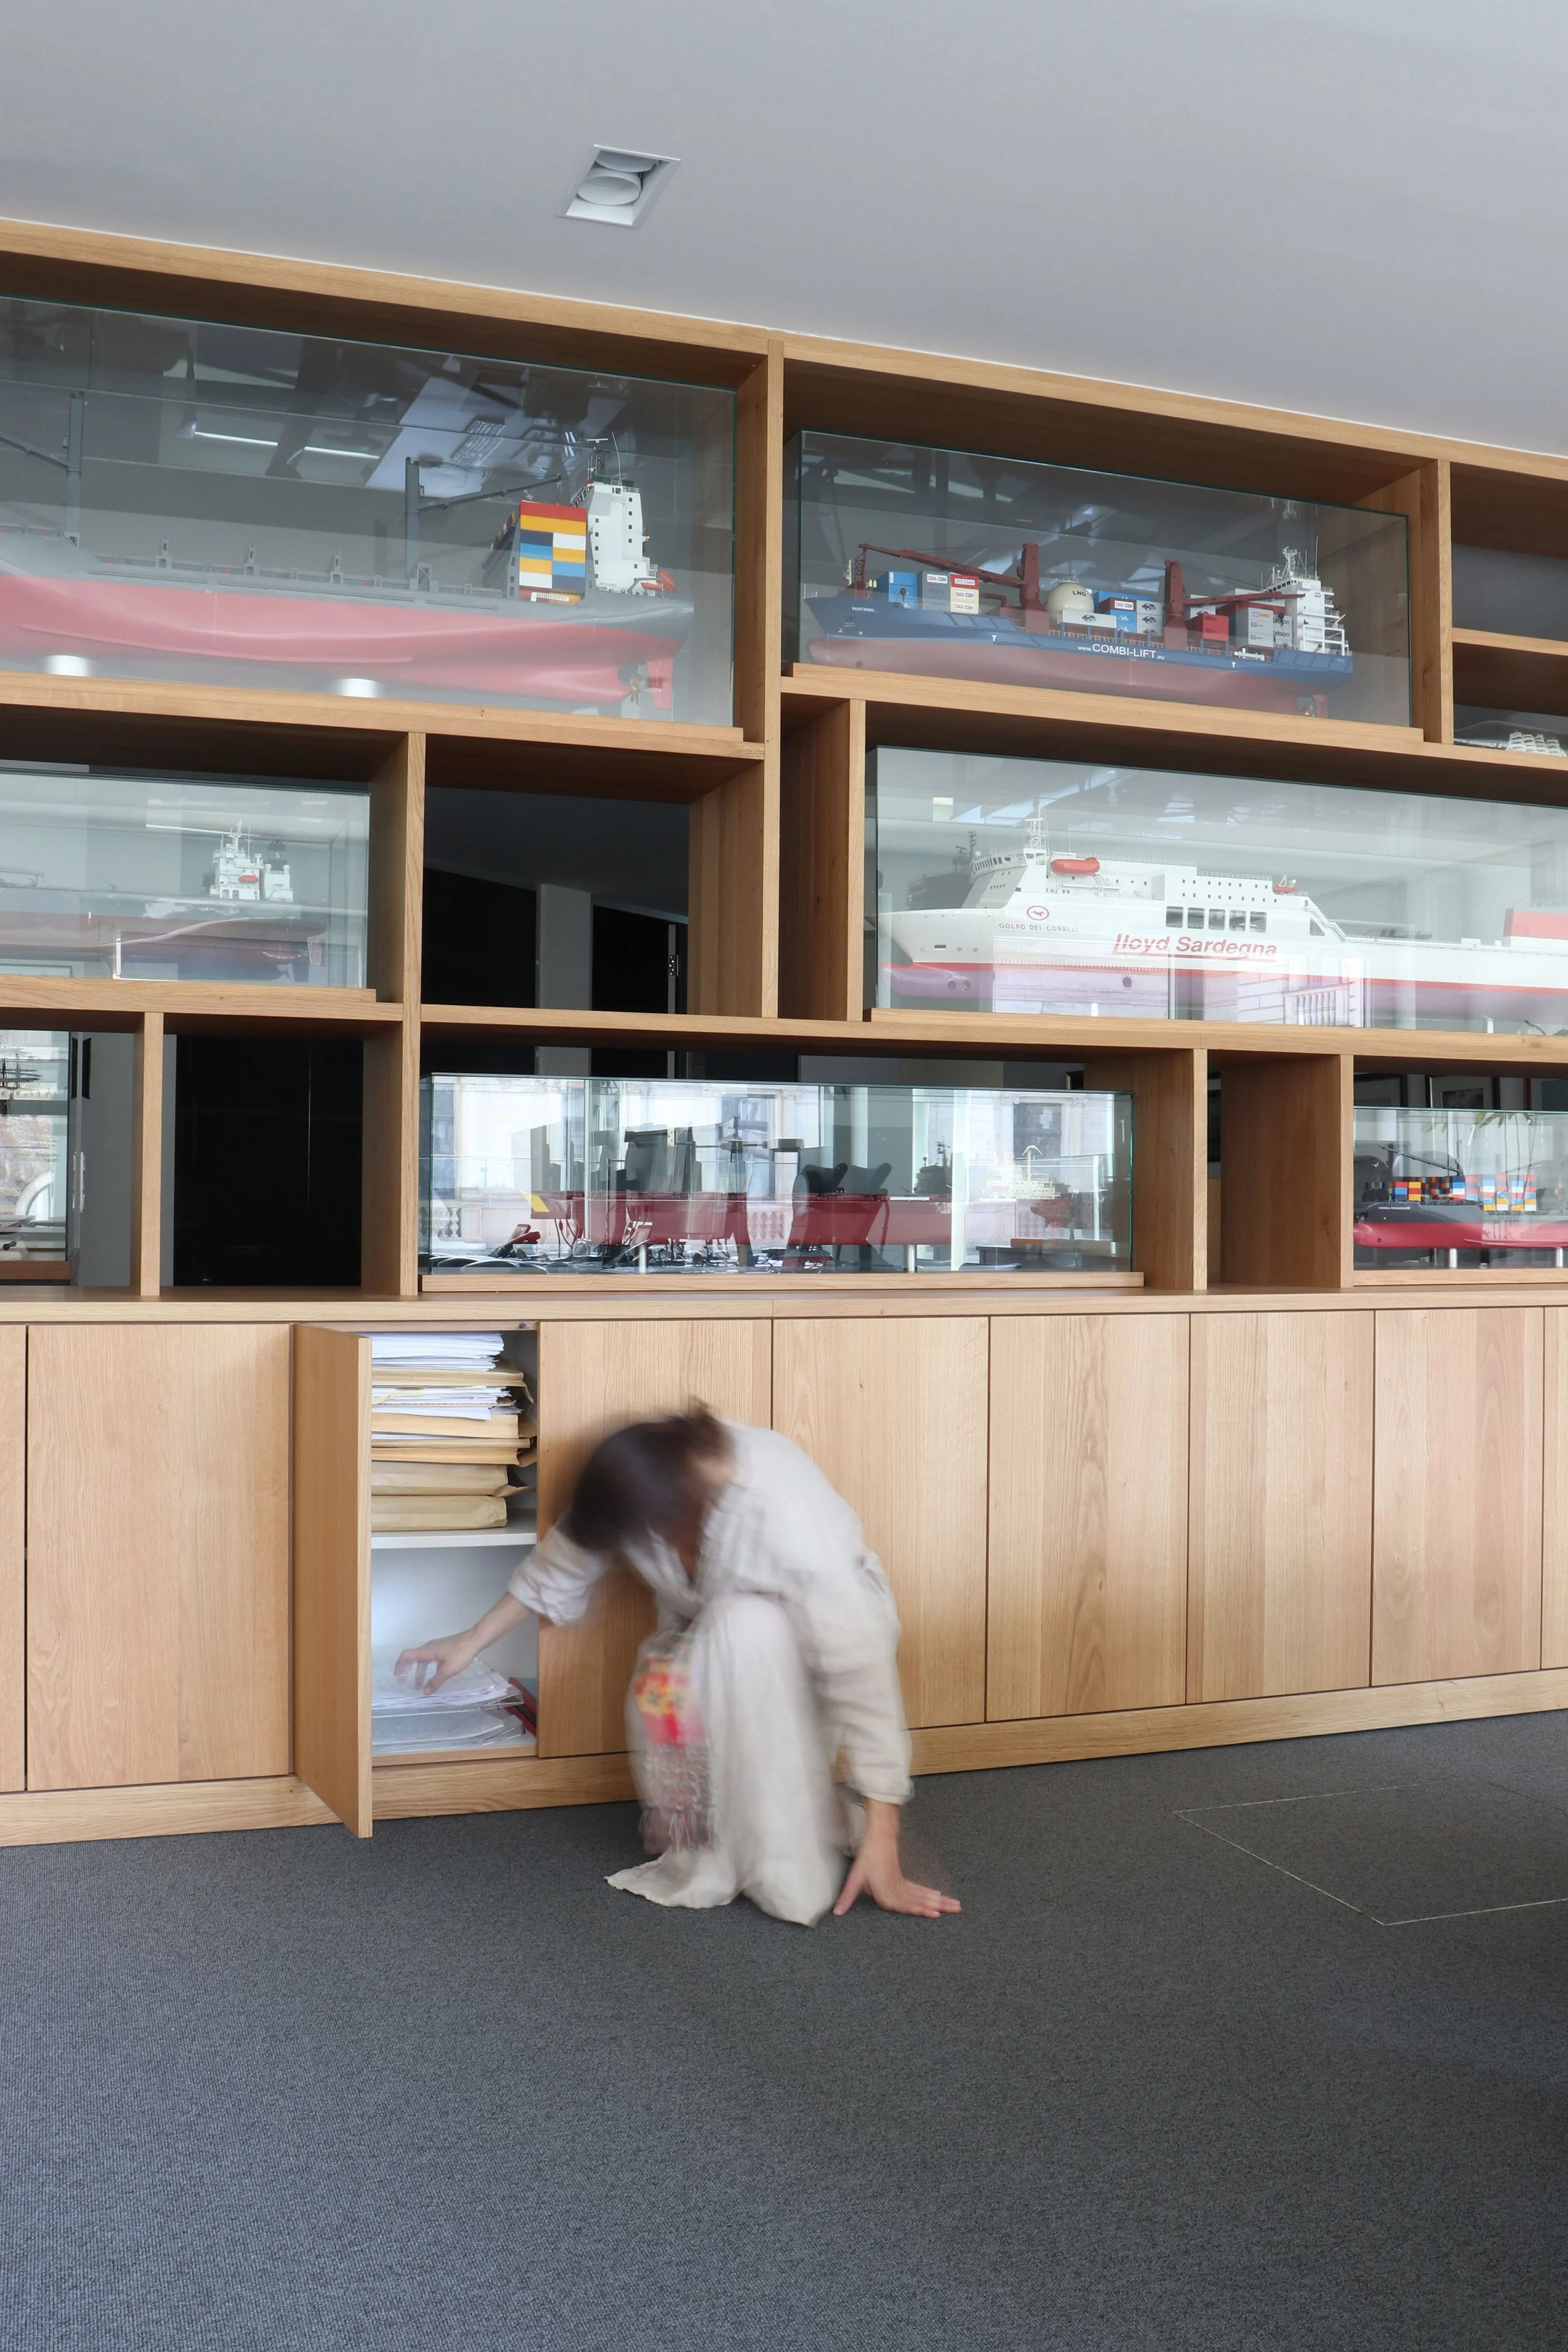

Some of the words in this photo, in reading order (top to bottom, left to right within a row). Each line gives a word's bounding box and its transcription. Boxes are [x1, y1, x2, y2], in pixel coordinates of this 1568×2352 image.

[1078, 643, 1165, 660] www.COMBI-LIFT.eu
[1046, 925, 1079, 933] CORALLI
[1111, 933, 1170, 954] Lloyd
[1175, 936, 1278, 959] Sardegna
